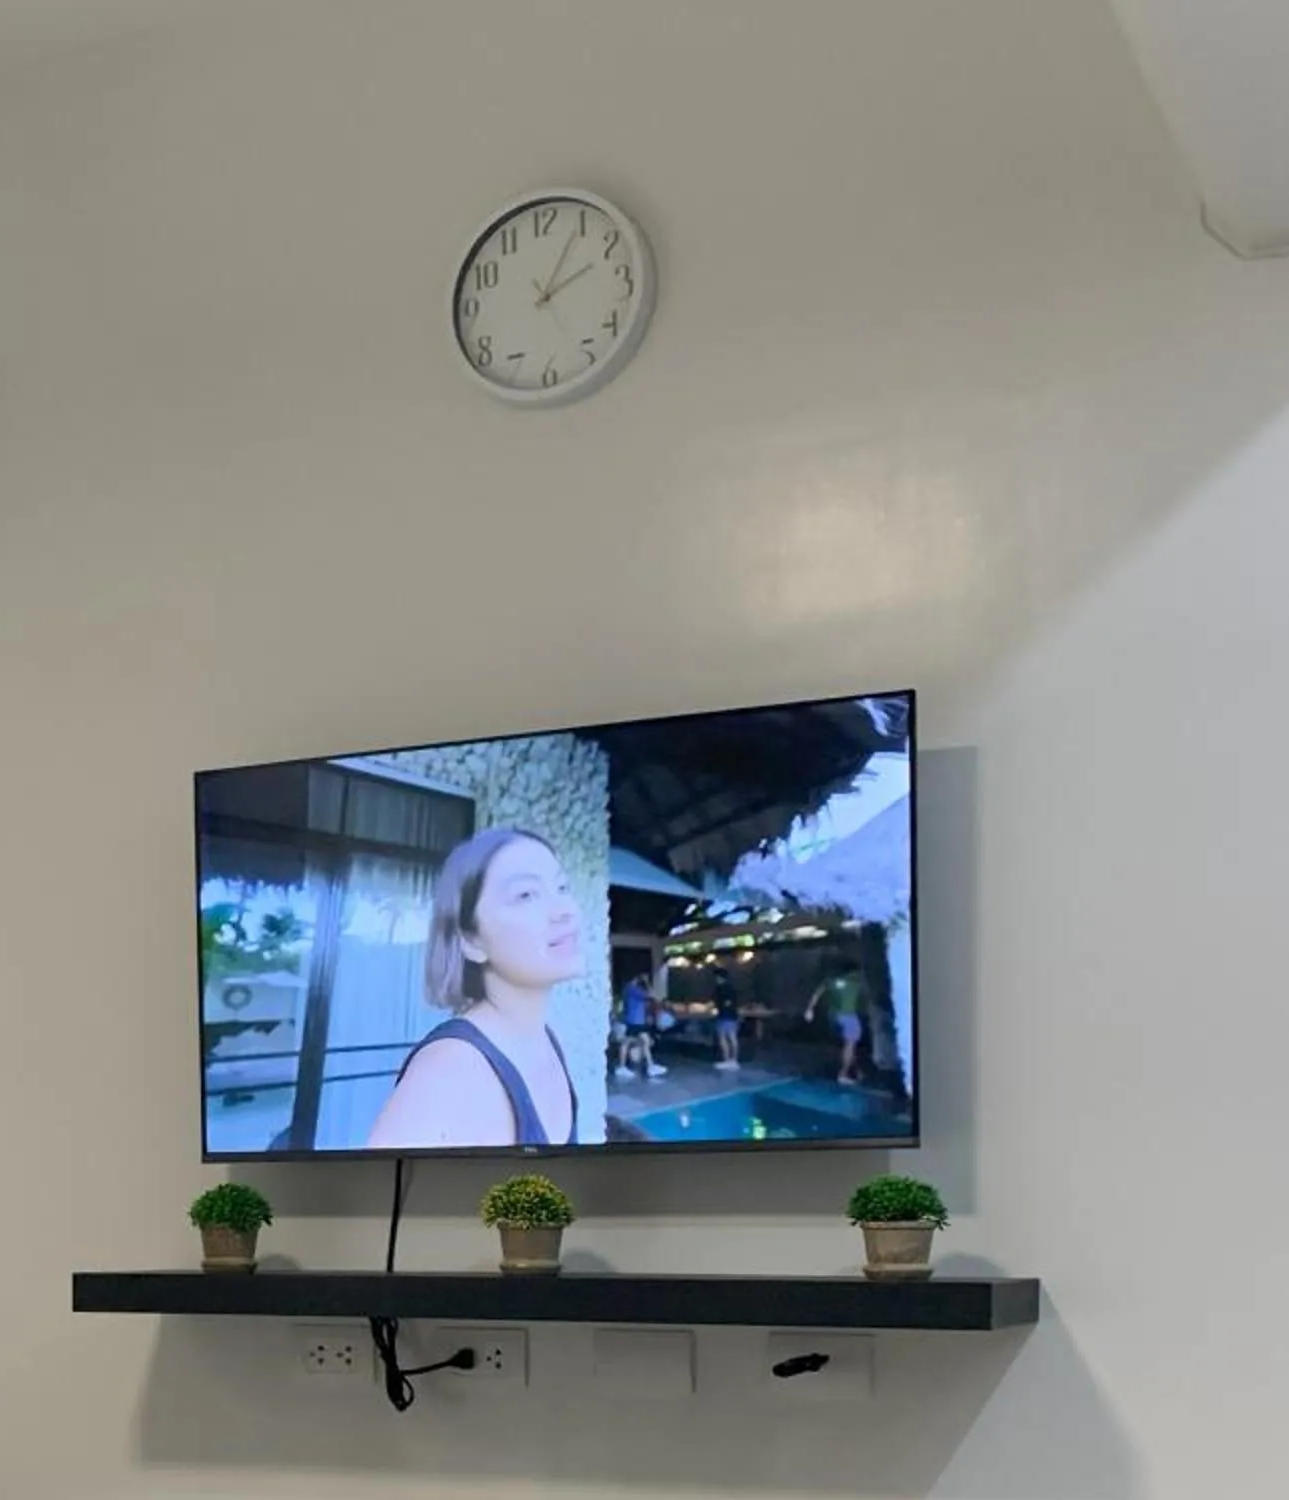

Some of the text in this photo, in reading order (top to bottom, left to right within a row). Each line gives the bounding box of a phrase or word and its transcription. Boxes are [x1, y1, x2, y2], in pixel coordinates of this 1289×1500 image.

[533, 207, 558, 238] 12
[579, 208, 587, 238] 1
[500, 226, 518, 256] 11
[603, 230, 620, 260] 2
[475, 261, 499, 291] 10
[615, 264, 634, 299] 3
[601, 309, 619, 338] 4
[478, 335, 493, 367] 8
[580, 338, 597, 367] 5
[542, 355, 558, 388] 6
